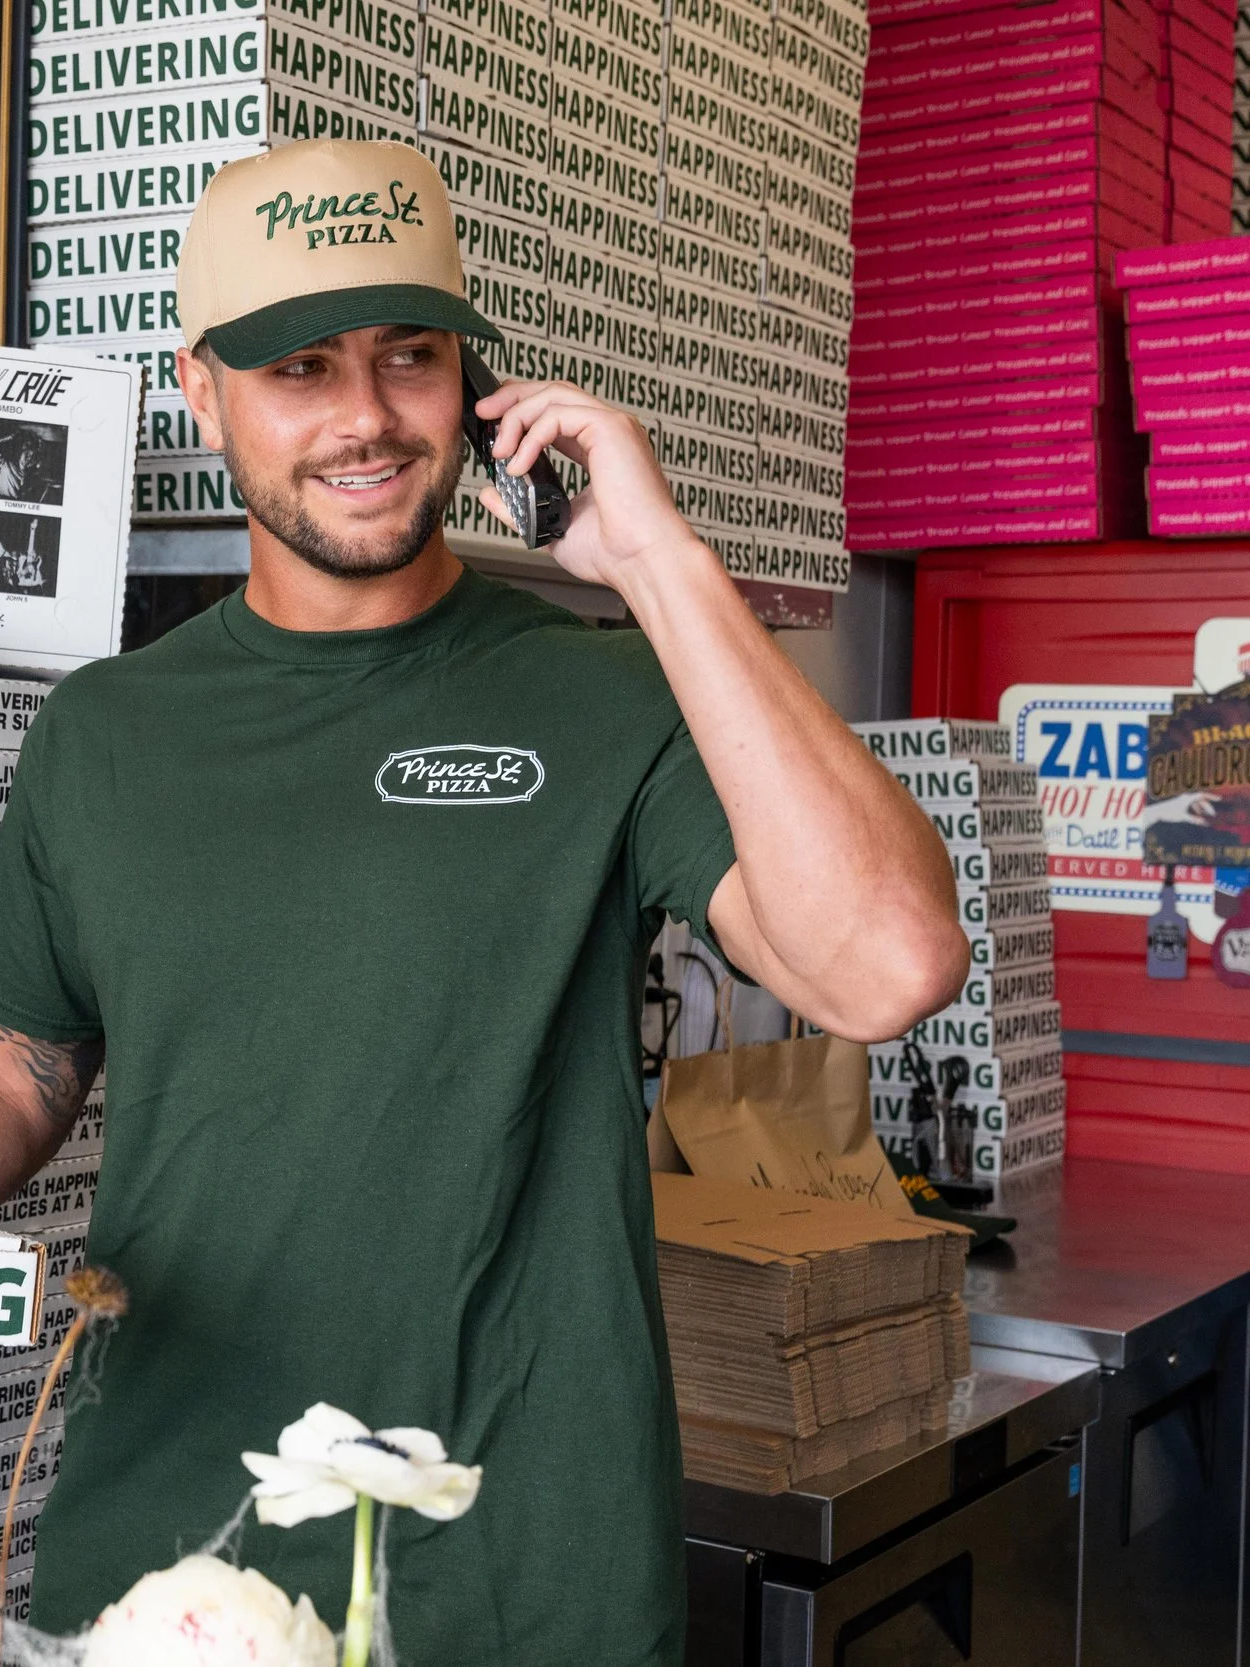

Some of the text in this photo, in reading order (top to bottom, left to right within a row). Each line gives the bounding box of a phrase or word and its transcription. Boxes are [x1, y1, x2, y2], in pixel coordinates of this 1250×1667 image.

[29, 31, 258, 96] DELIVERING
[270, 27, 417, 118] HAPPINESS
[426, 25, 548, 109] HAPPINESS
[554, 26, 662, 106] HAPPINESS
[672, 34, 769, 107] HAPPINESS
[775, 26, 862, 101] HAPPINESS
[28, 95, 261, 158] DELIVERING
[553, 136, 658, 208] HAPPINESS
[667, 132, 761, 200] HAPPINESS
[767, 123, 854, 191] HAPPINESS
[27, 160, 217, 217] DELIVERIN
[256, 180, 424, 240] Prince St.
[31, 229, 179, 279] DELIVER
[306, 223, 398, 250] PIZZA
[455, 214, 545, 274] PPINESS
[550, 246, 657, 312] HAPPINESS
[662, 232, 758, 294] HAPPINESS
[29, 293, 179, 338] DELIVER
[661, 332, 758, 388] HAPPINESS
[759, 358, 846, 412] HAPPINESS
[1, 368, 73, 407] CRÜE
[662, 431, 754, 484] HAPPINESS
[3, 501, 27, 510] TOMMY
[755, 496, 845, 543] HAPPINESS
[756, 544, 849, 586] HAPPINESS
[952, 727, 1010, 750] HAPPINESS
[397, 754, 523, 784] Prince St.
[426, 779, 491, 793] PIZZA
[981, 768, 1037, 796] HAPPINESS
[983, 806, 1043, 835] HAPPINESS
[1041, 785, 1098, 818] HOT
[1054, 858, 1129, 878] ERVED
[989, 888, 1050, 919] HAPPINESS
[995, 971, 1054, 1001] HAPPINESS
[1002, 1051, 1061, 1088] HAPPINESS
[1002, 1129, 1063, 1167] HAPPINESS
[52, 1193, 71, 1213] AT
